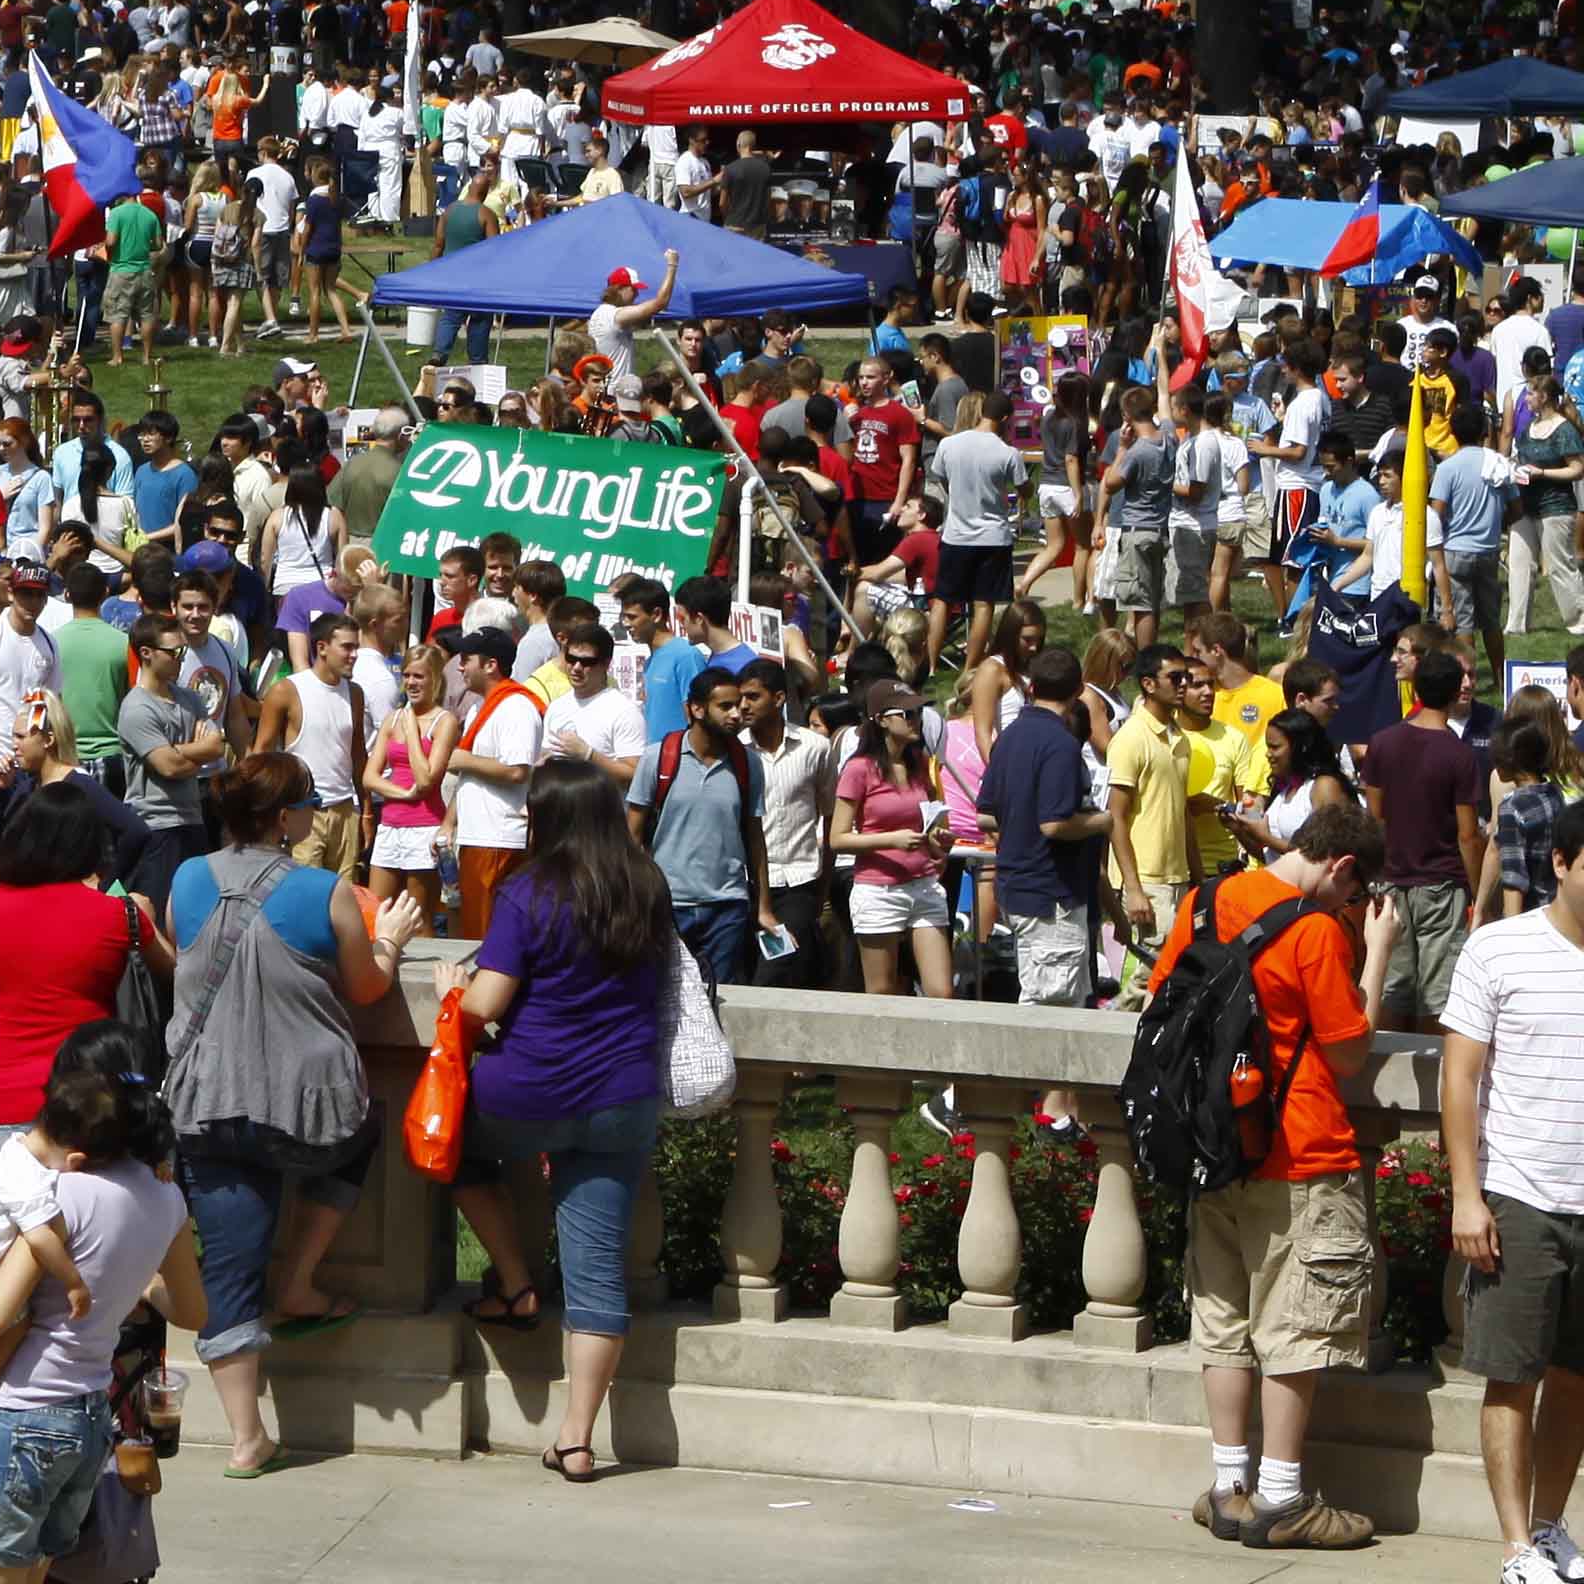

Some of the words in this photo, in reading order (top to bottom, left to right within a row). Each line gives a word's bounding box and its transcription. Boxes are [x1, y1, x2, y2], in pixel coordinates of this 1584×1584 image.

[689, 105, 751, 116] MARINE
[760, 103, 833, 114] OFFICER
[839, 101, 930, 112] PROGRAMS
[400, 527, 430, 558] at
[561, 550, 594, 583] of
